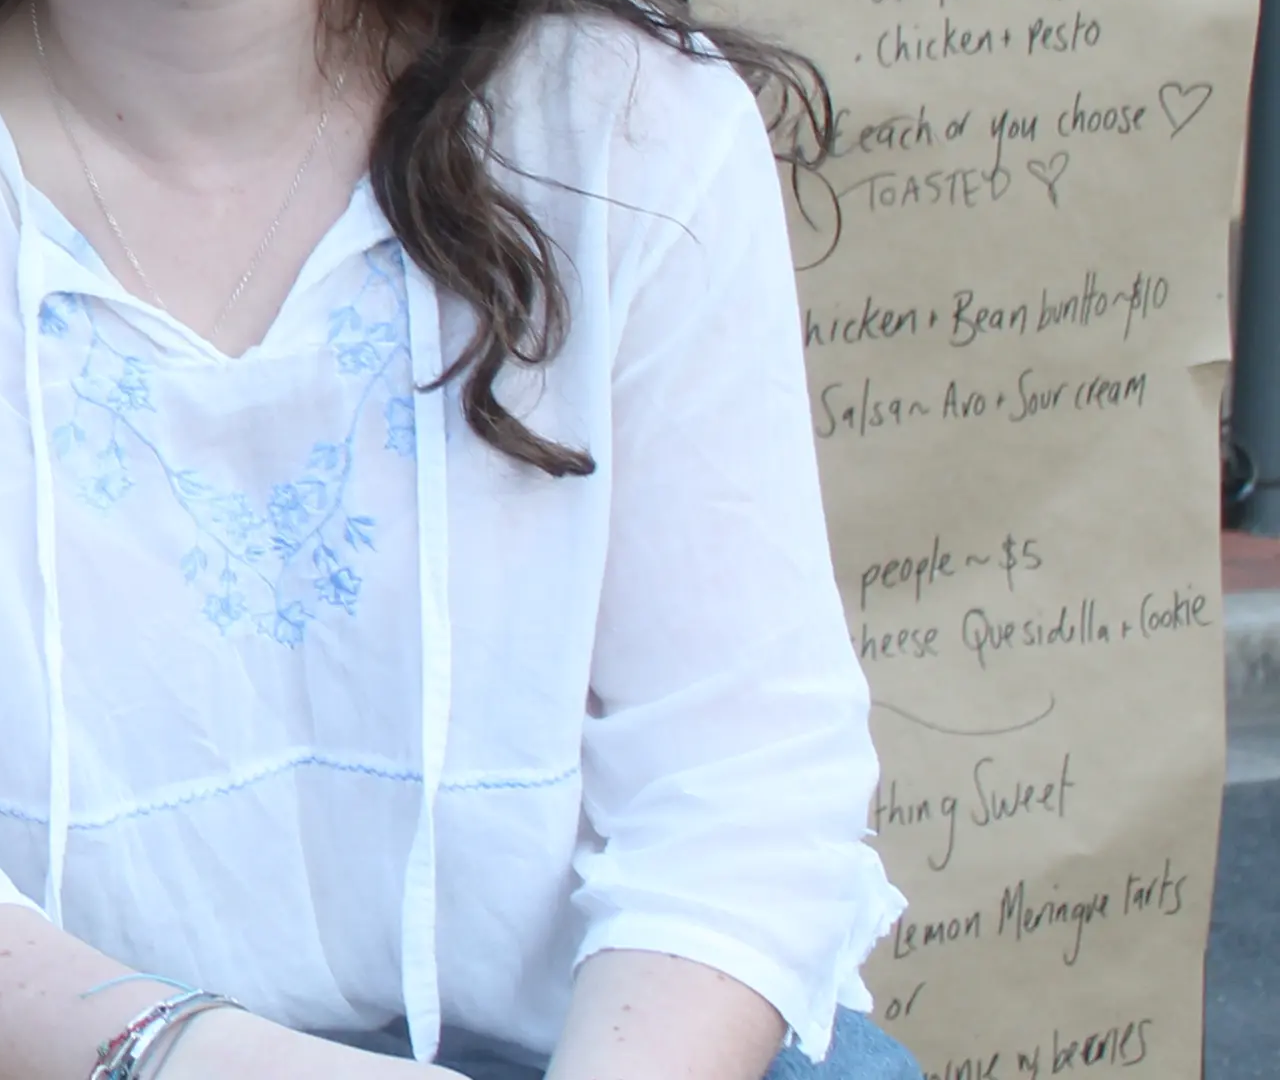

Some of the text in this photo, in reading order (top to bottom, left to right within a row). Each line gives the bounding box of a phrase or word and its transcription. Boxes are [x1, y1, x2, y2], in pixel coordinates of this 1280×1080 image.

[859, 104, 933, 153] each
[990, 108, 1038, 181] you
[1057, 90, 1147, 138] choose
[804, 295, 917, 348] hicken
[949, 288, 1028, 348] Bean
[815, 376, 903, 439] Salsa
[860, 534, 955, 612] people
[998, 532, 1043, 592] $5
[850, 622, 940, 662] heese
[874, 779, 958, 872] thing
[893, 910, 982, 960] Lemon
[884, 981, 927, 1022] or
